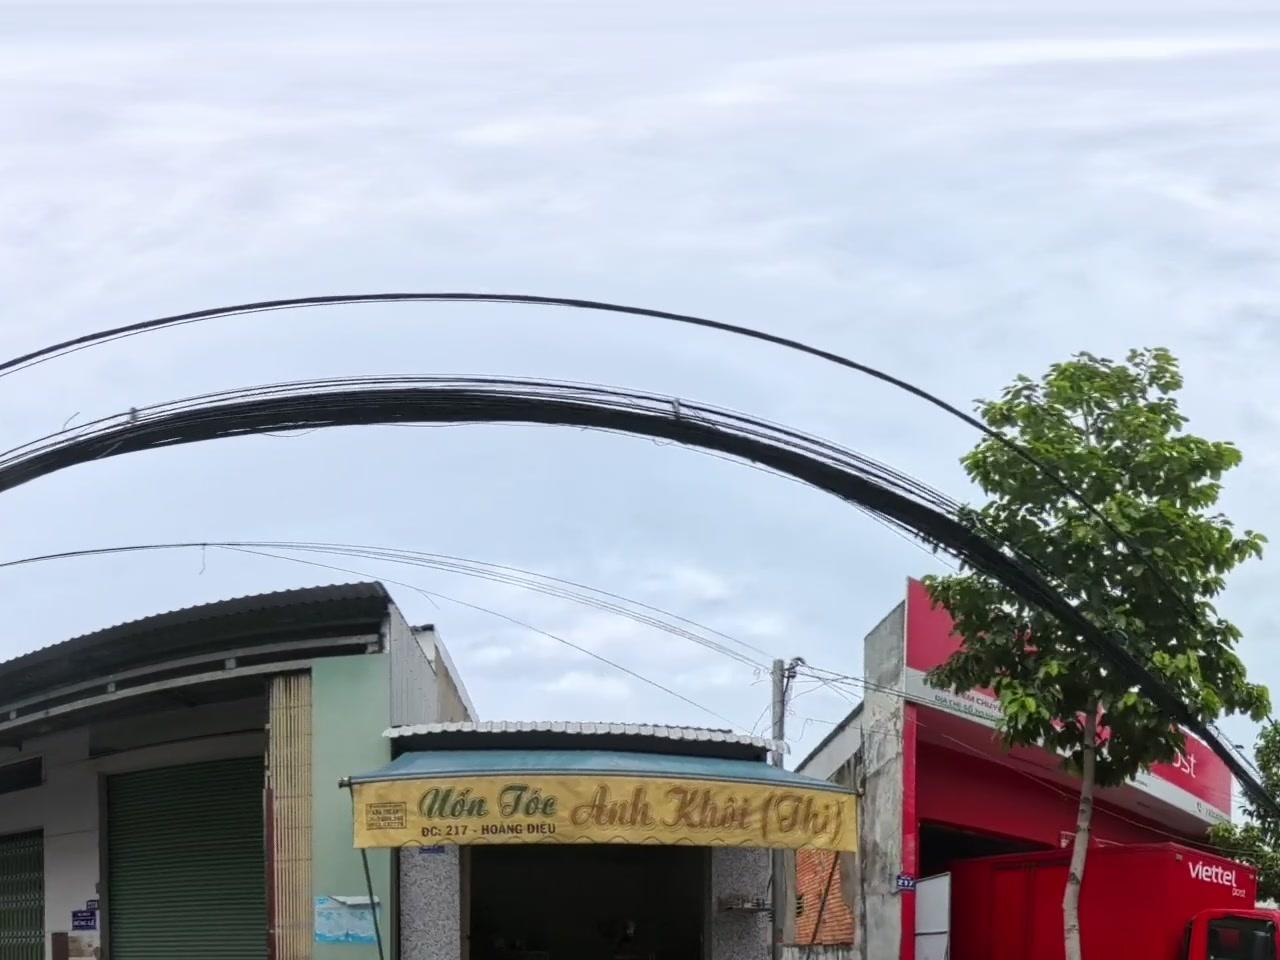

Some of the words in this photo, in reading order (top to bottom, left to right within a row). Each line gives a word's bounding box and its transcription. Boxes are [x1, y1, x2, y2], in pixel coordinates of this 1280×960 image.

[419, 785, 488, 818] Uốn
[570, 784, 654, 828] Anh
[445, 825, 468, 836] 217
[1188, 861, 1237, 887] viettel
